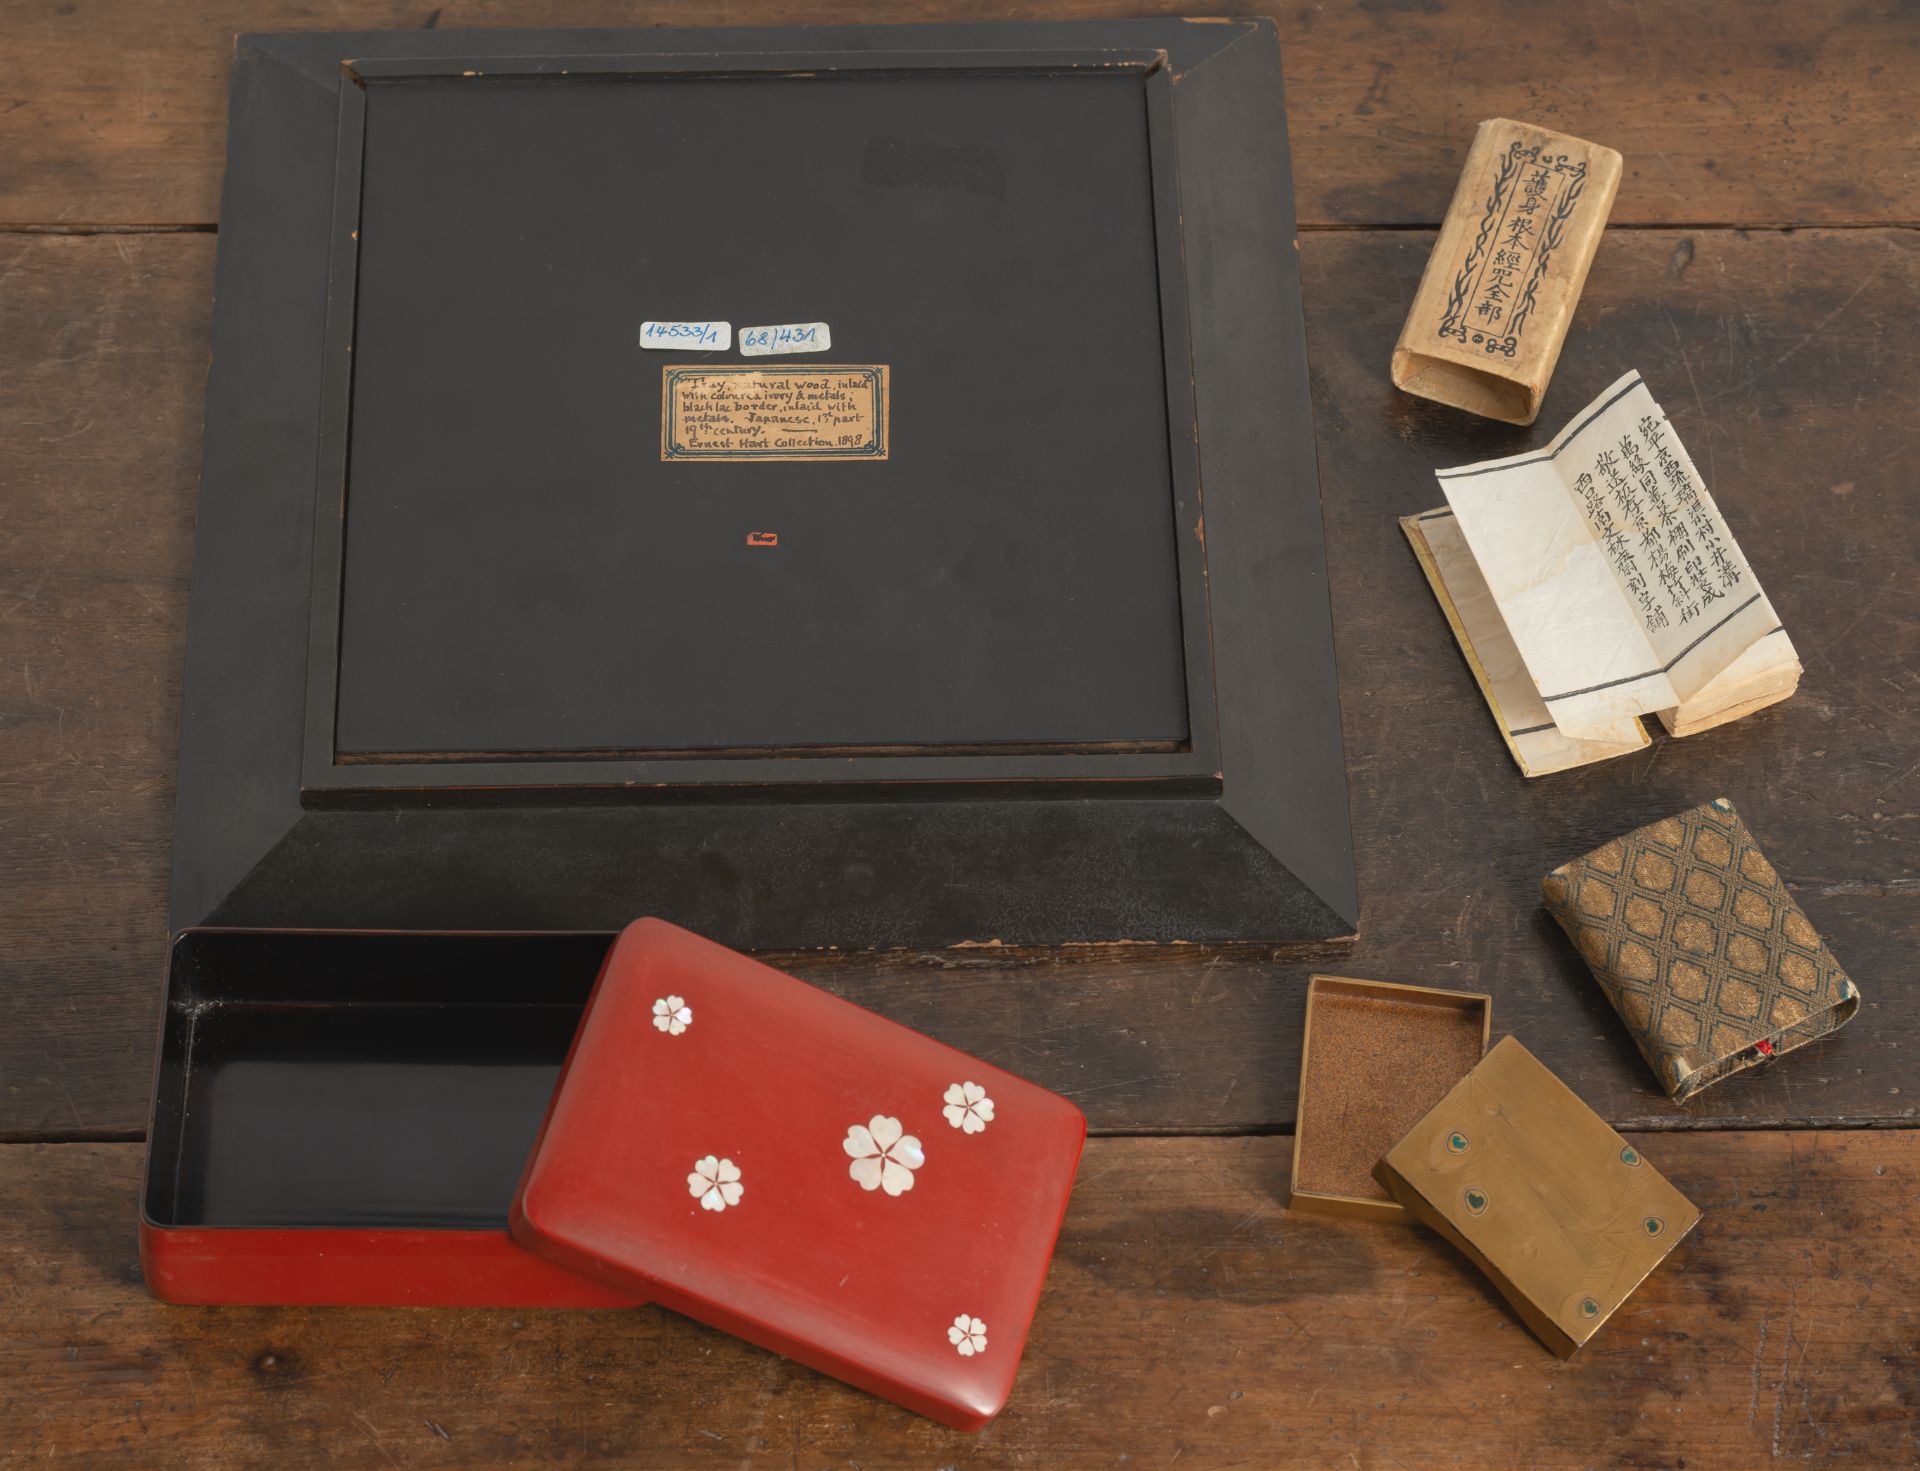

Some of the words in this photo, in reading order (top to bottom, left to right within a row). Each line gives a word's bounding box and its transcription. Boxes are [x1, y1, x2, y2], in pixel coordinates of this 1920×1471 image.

[645, 323, 717, 344] 14533/1
[745, 328, 816, 350] 68/431
[838, 378, 868, 389] inlaid
[764, 391, 793, 404] ivory
[796, 390, 804, 400] &
[683, 402, 712, 412] black
[716, 402, 731, 412] lac
[783, 401, 822, 411] inlaid
[828, 401, 857, 411] with
[833, 413, 864, 426] part
[689, 437, 734, 448] Ernest
[739, 438, 771, 448] Hart
[838, 434, 863, 447] 1898
